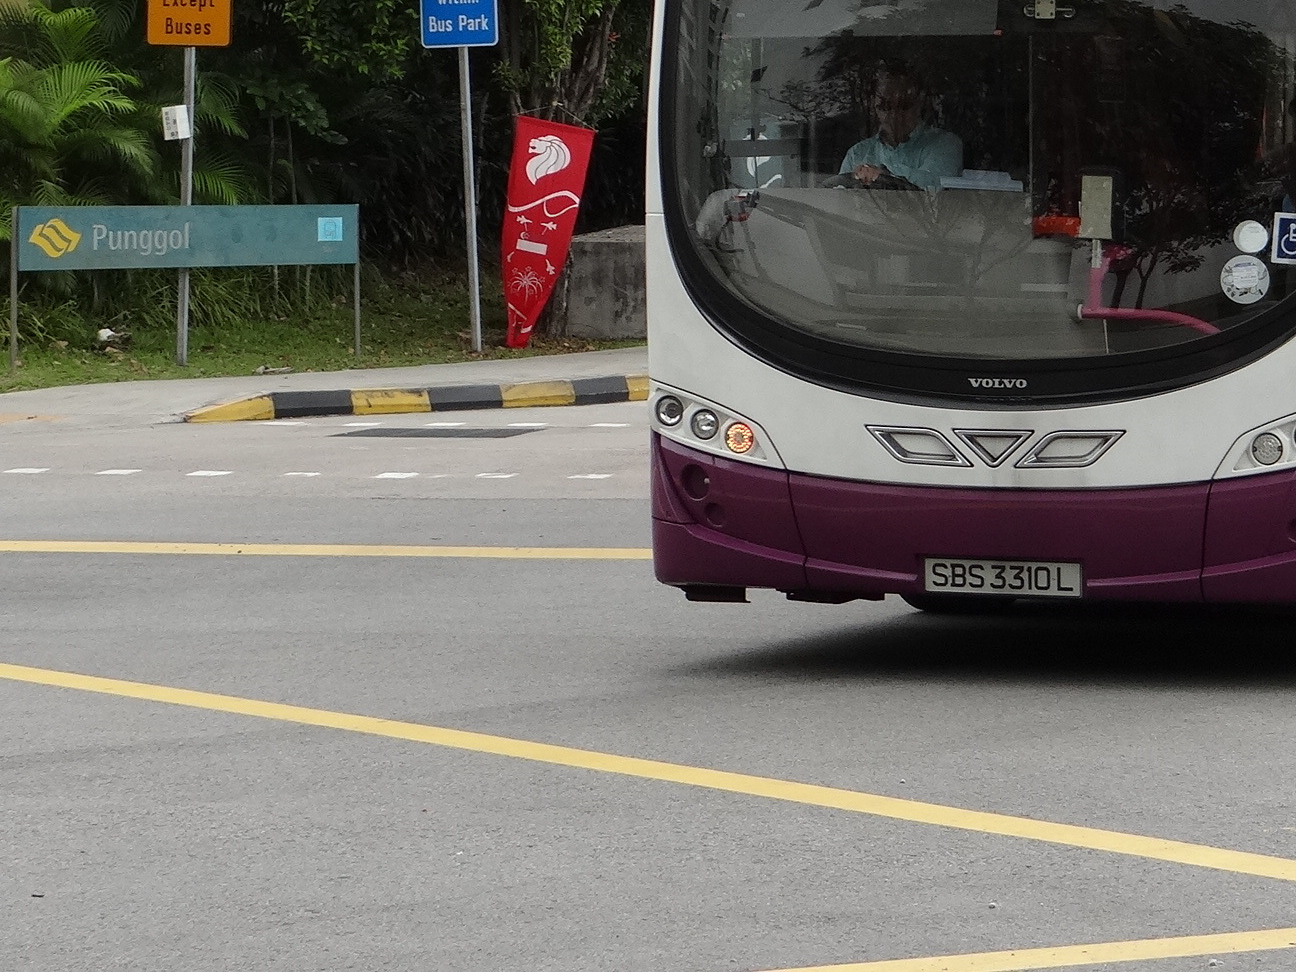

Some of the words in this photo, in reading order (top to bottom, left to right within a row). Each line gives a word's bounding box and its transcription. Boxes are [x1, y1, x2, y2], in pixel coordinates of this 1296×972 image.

[165, 17, 212, 35] Buses
[428, 16, 453, 33] Bus
[458, 14, 489, 31] Park
[91, 222, 191, 256] Punggol
[967, 377, 1028, 389] VOLVO
